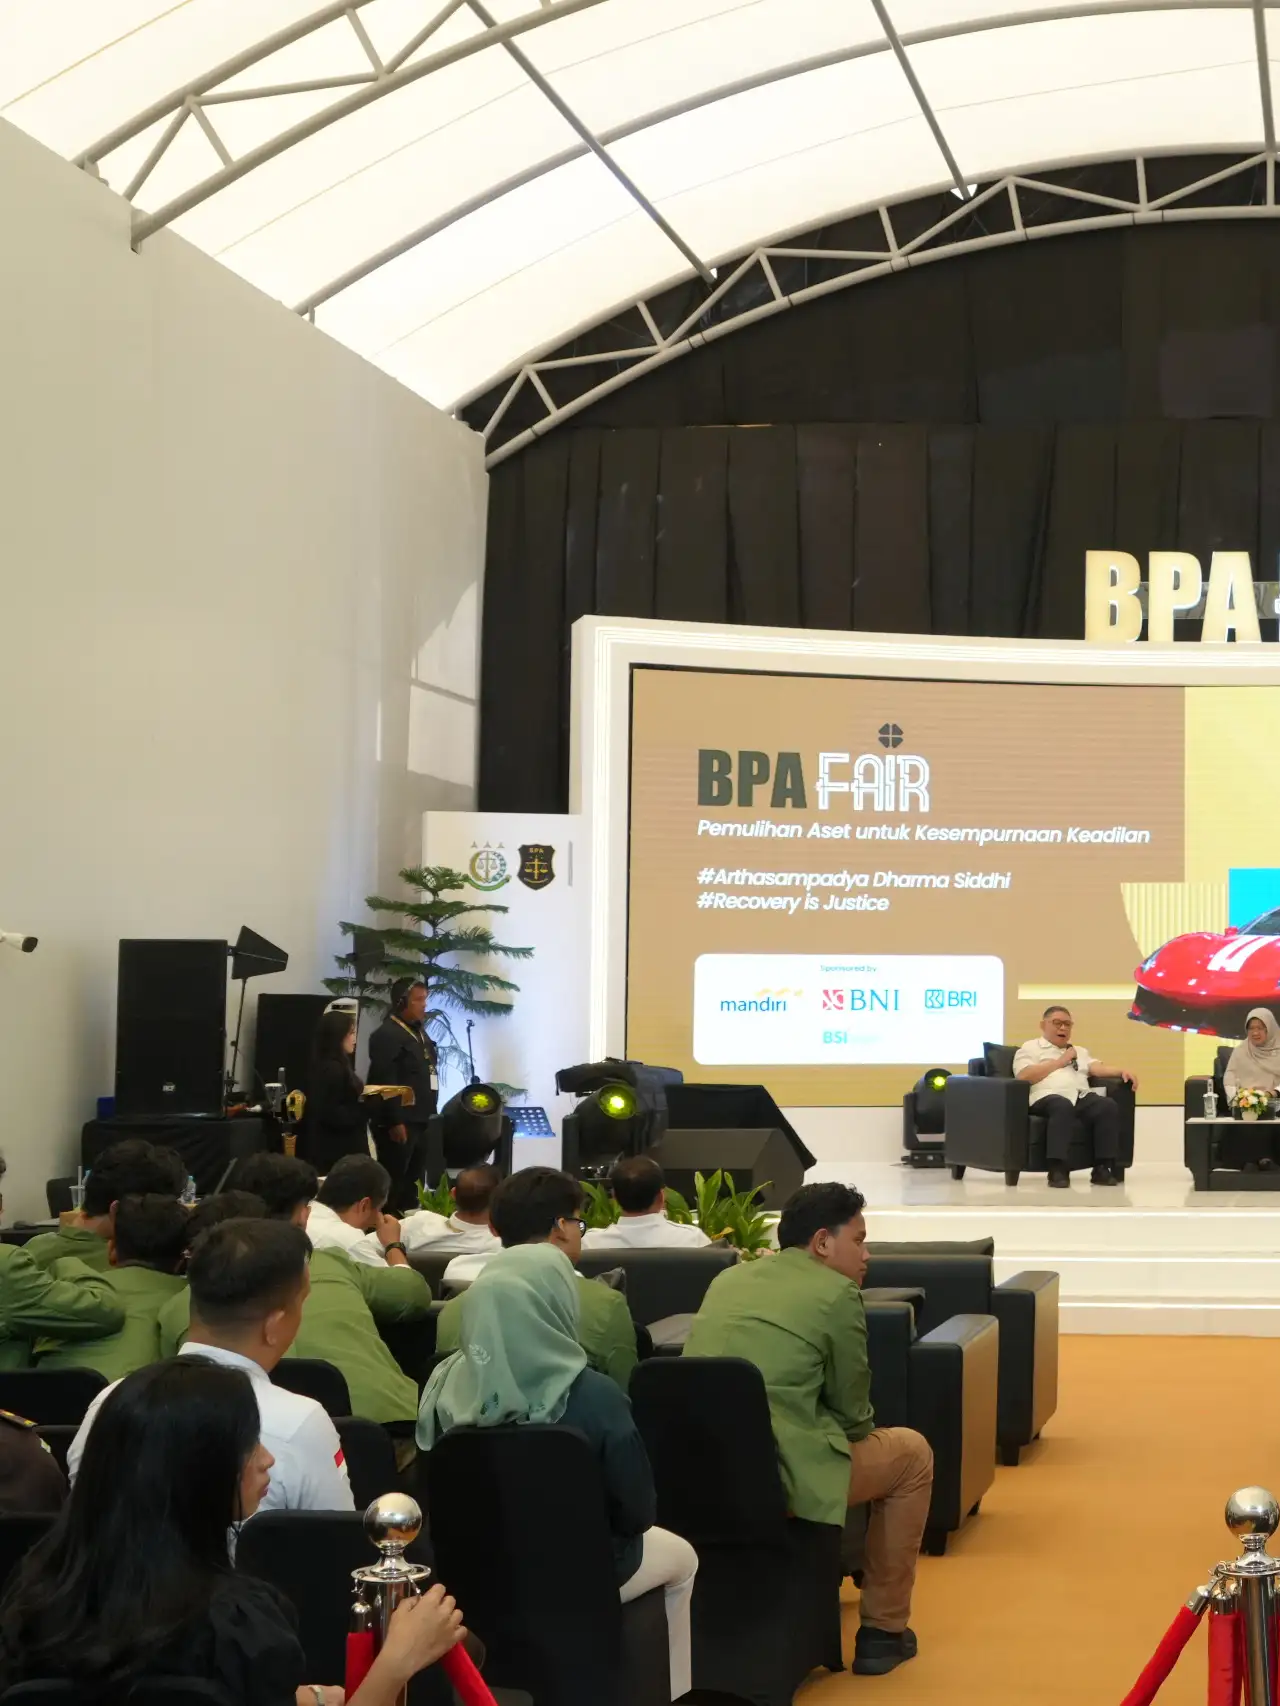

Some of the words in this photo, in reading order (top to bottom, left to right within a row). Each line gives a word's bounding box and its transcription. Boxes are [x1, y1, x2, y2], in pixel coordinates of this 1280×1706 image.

[1085, 550, 1262, 642] BPA
[697, 749, 807, 809] BPA
[816, 752, 930, 812] FAIR
[697, 819, 803, 838] Pemulihan
[807, 822, 852, 839] Aset
[855, 823, 912, 841] untuk
[915, 824, 1062, 846] Kesempurnaan
[1066, 825, 1150, 844] Keadilan
[696, 867, 869, 892] #Arthasampadya
[873, 870, 949, 888] Dharma
[953, 871, 1012, 889] Siddhi
[696, 891, 801, 915] #Recovery
[804, 893, 819, 910] is
[823, 893, 890, 911] Justice
[820, 964, 865, 972] Sponsored
[720, 996, 787, 1012] mandiri
[850, 989, 900, 1011] BNI
[948, 990, 977, 1007] BRI
[823, 1031, 848, 1044] BSI
